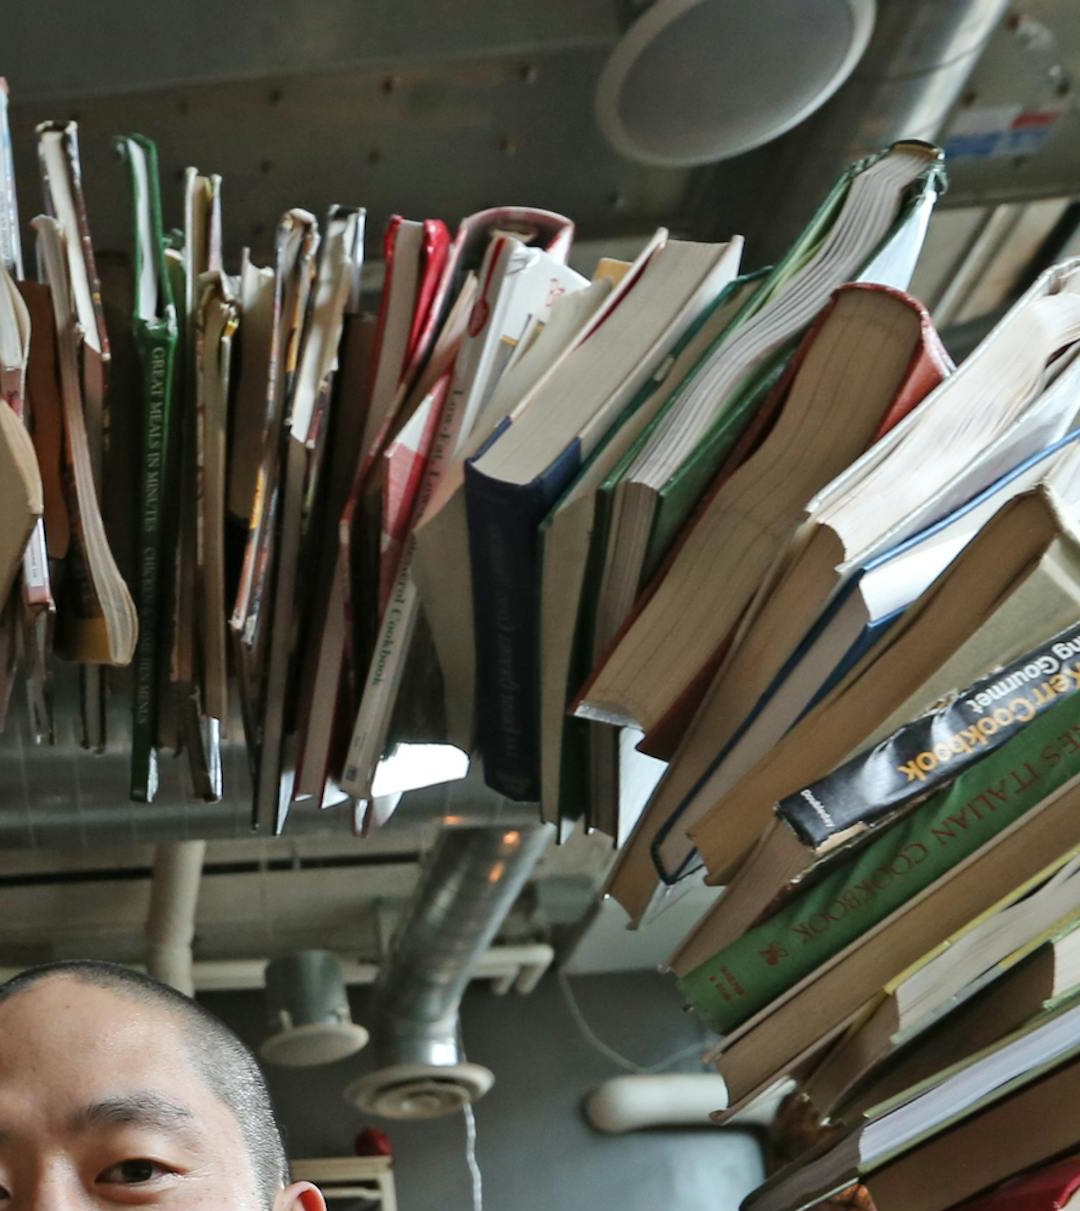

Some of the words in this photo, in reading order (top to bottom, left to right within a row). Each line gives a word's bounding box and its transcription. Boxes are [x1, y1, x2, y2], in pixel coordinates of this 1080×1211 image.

[150, 346, 165, 396] GREAT
[147, 400, 163, 450] MEALS
[146, 451, 161, 468] IN
[143, 470, 160, 533] MINUTES
[371, 611, 402, 686] Cookbook
[966, 655, 1060, 714] Gourmet
[897, 697, 1037, 783] Cookbook
[931, 761, 1040, 847] ITALIAN
[792, 842, 928, 941] COOKBOOK
